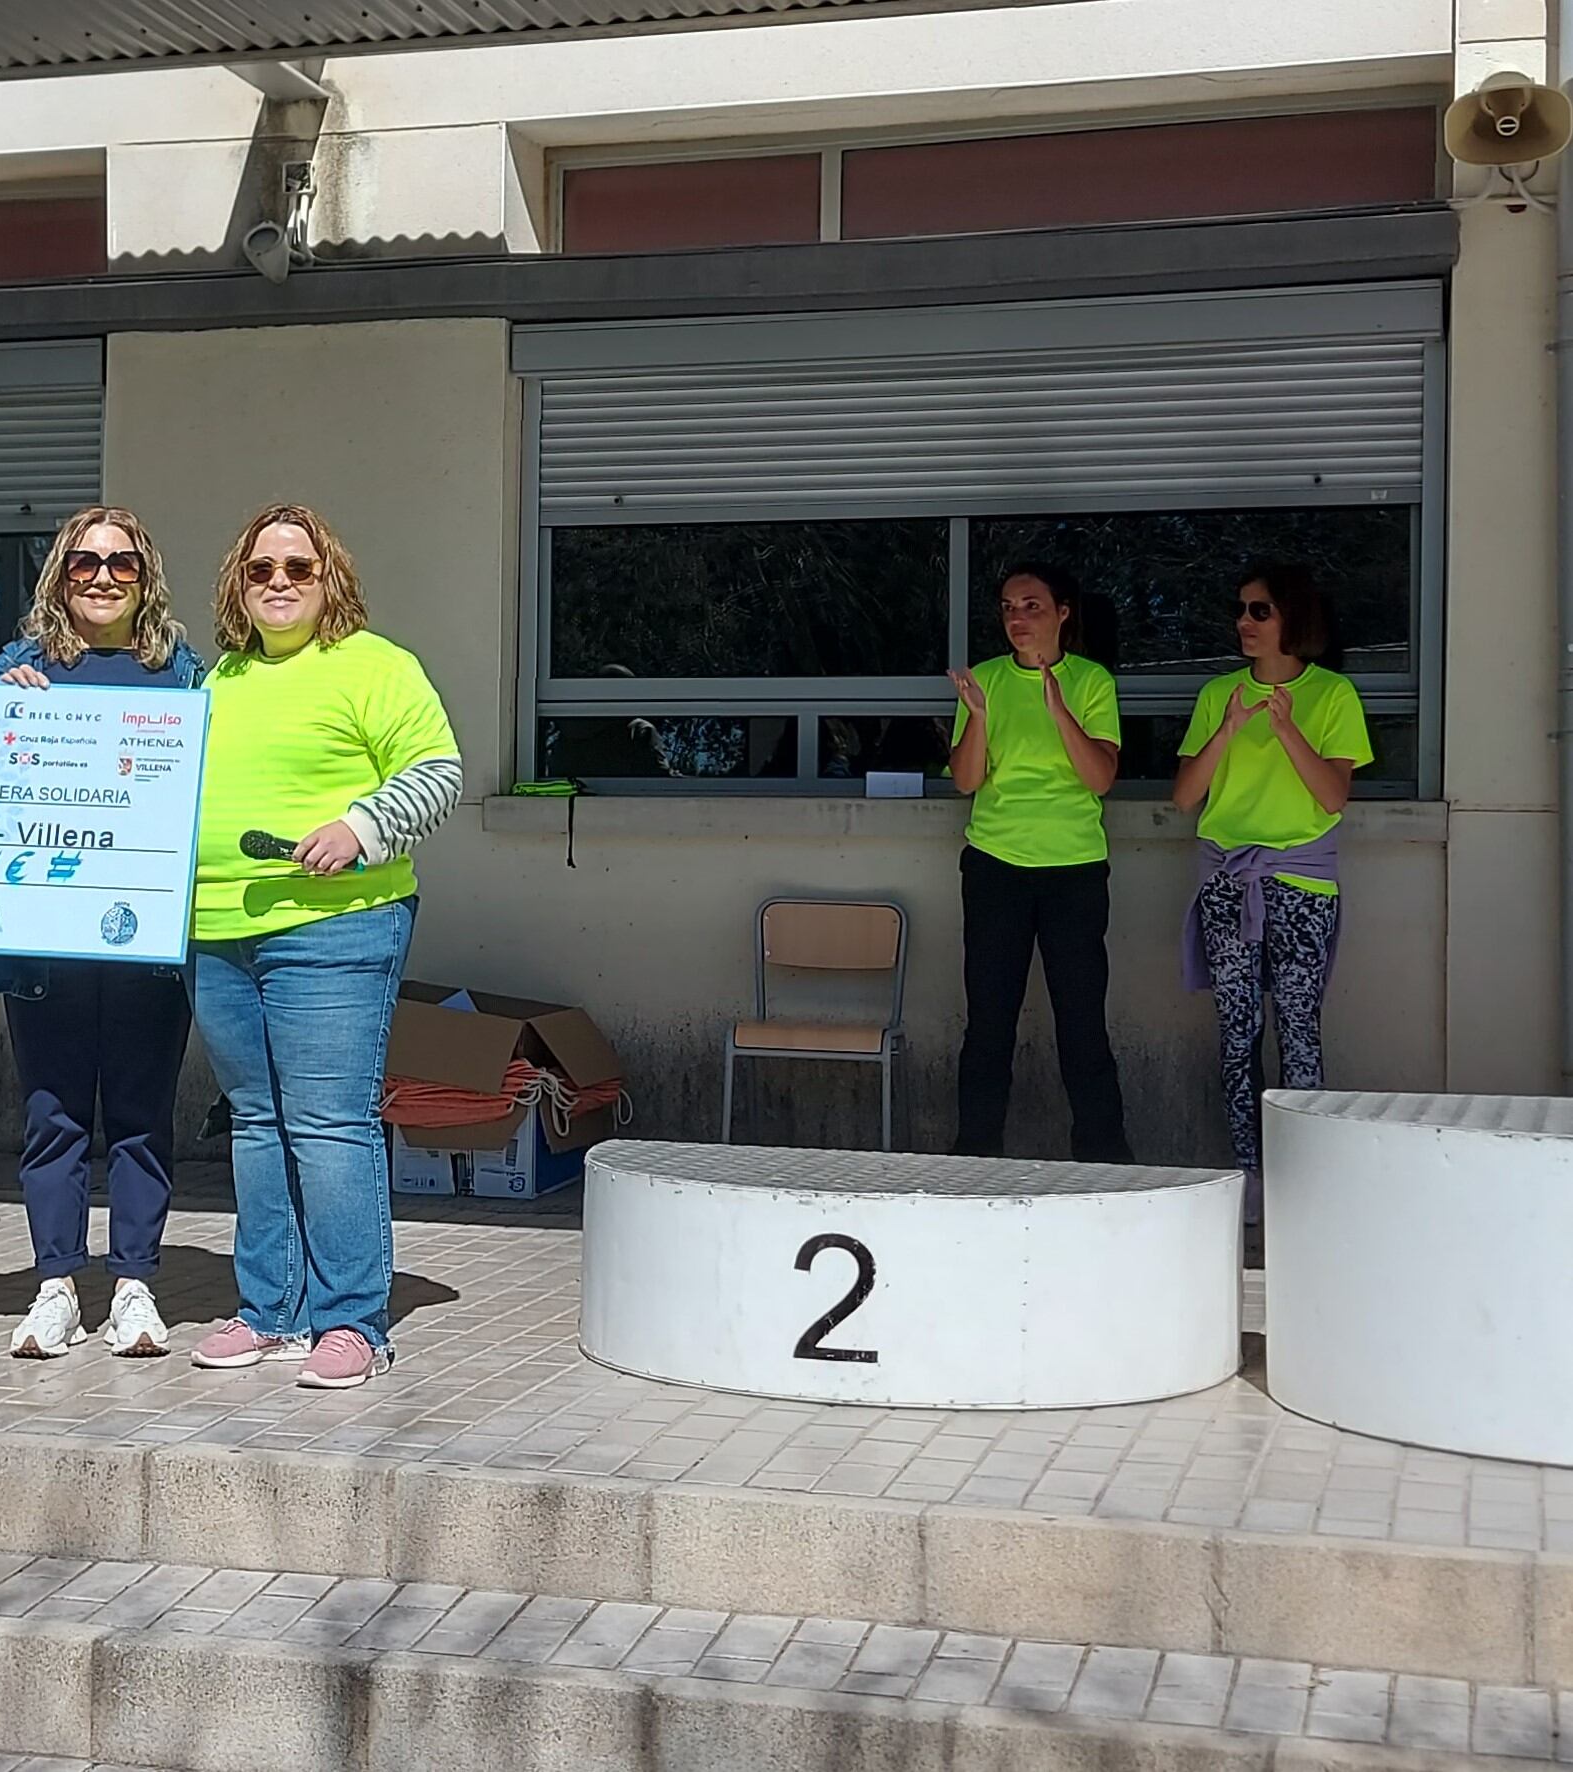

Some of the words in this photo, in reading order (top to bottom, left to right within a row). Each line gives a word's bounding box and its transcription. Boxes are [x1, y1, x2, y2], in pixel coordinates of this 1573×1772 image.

[122, 711, 182, 728] Impulso
[19, 735, 38, 744] Cruz
[40, 735, 58, 745] Roja
[119, 737, 184, 748] ATHENEA
[135, 763, 172, 773] VILLENA
[38, 787, 131, 805] SOLIDARIA
[17, 821, 114, 848] Villena
[793, 1233, 879, 1364] 2
